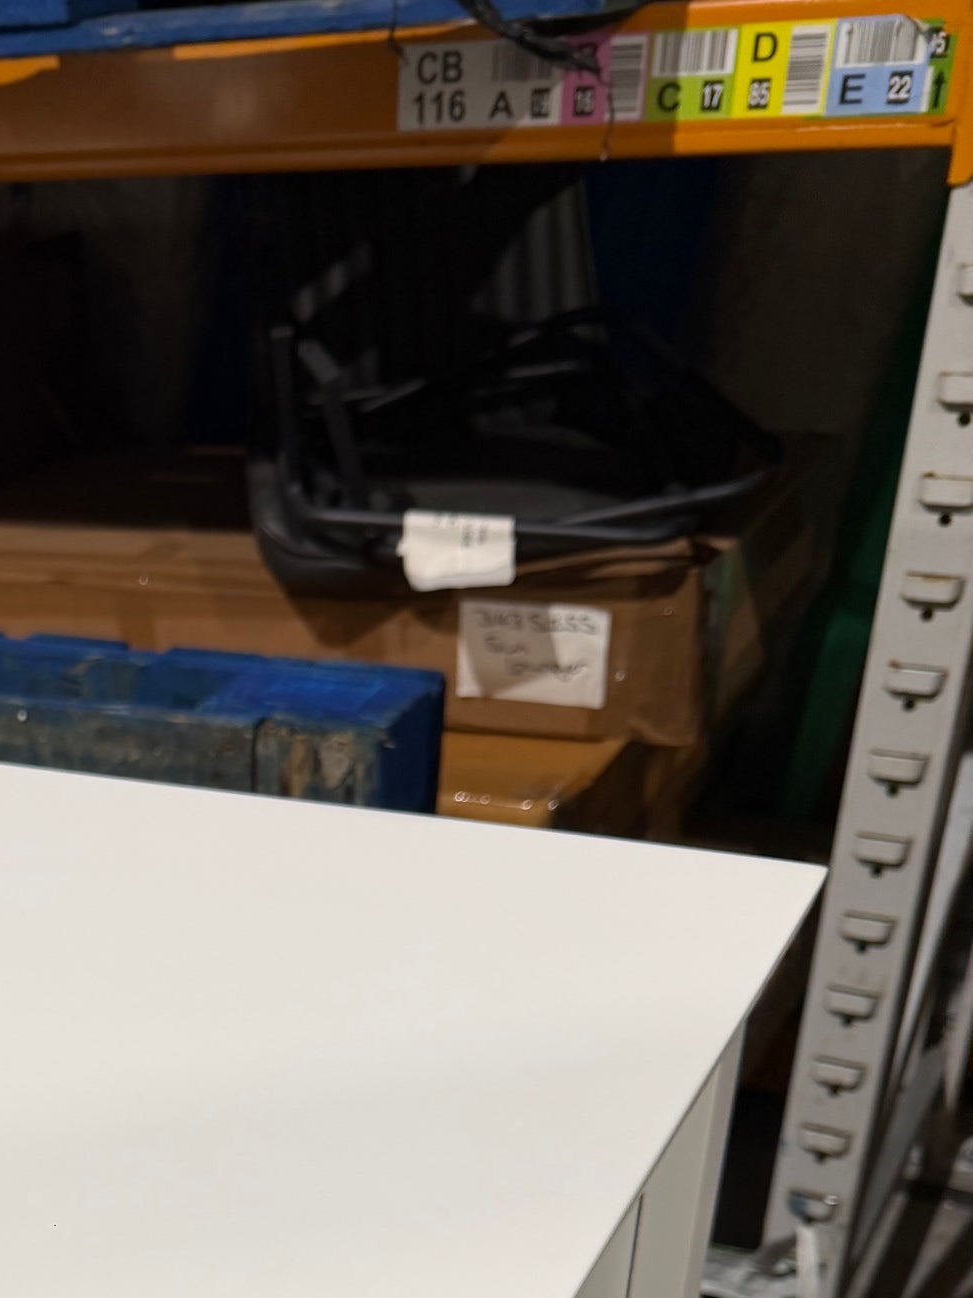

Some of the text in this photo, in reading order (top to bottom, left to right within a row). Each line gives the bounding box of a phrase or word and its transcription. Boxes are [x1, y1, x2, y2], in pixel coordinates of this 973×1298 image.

[752, 33, 778, 62] D
[417, 50, 464, 85] CB
[656, 82, 724, 112] C 17
[839, 73, 912, 105] E 22
[413, 89, 466, 125] 116
[488, 91, 513, 119] A
